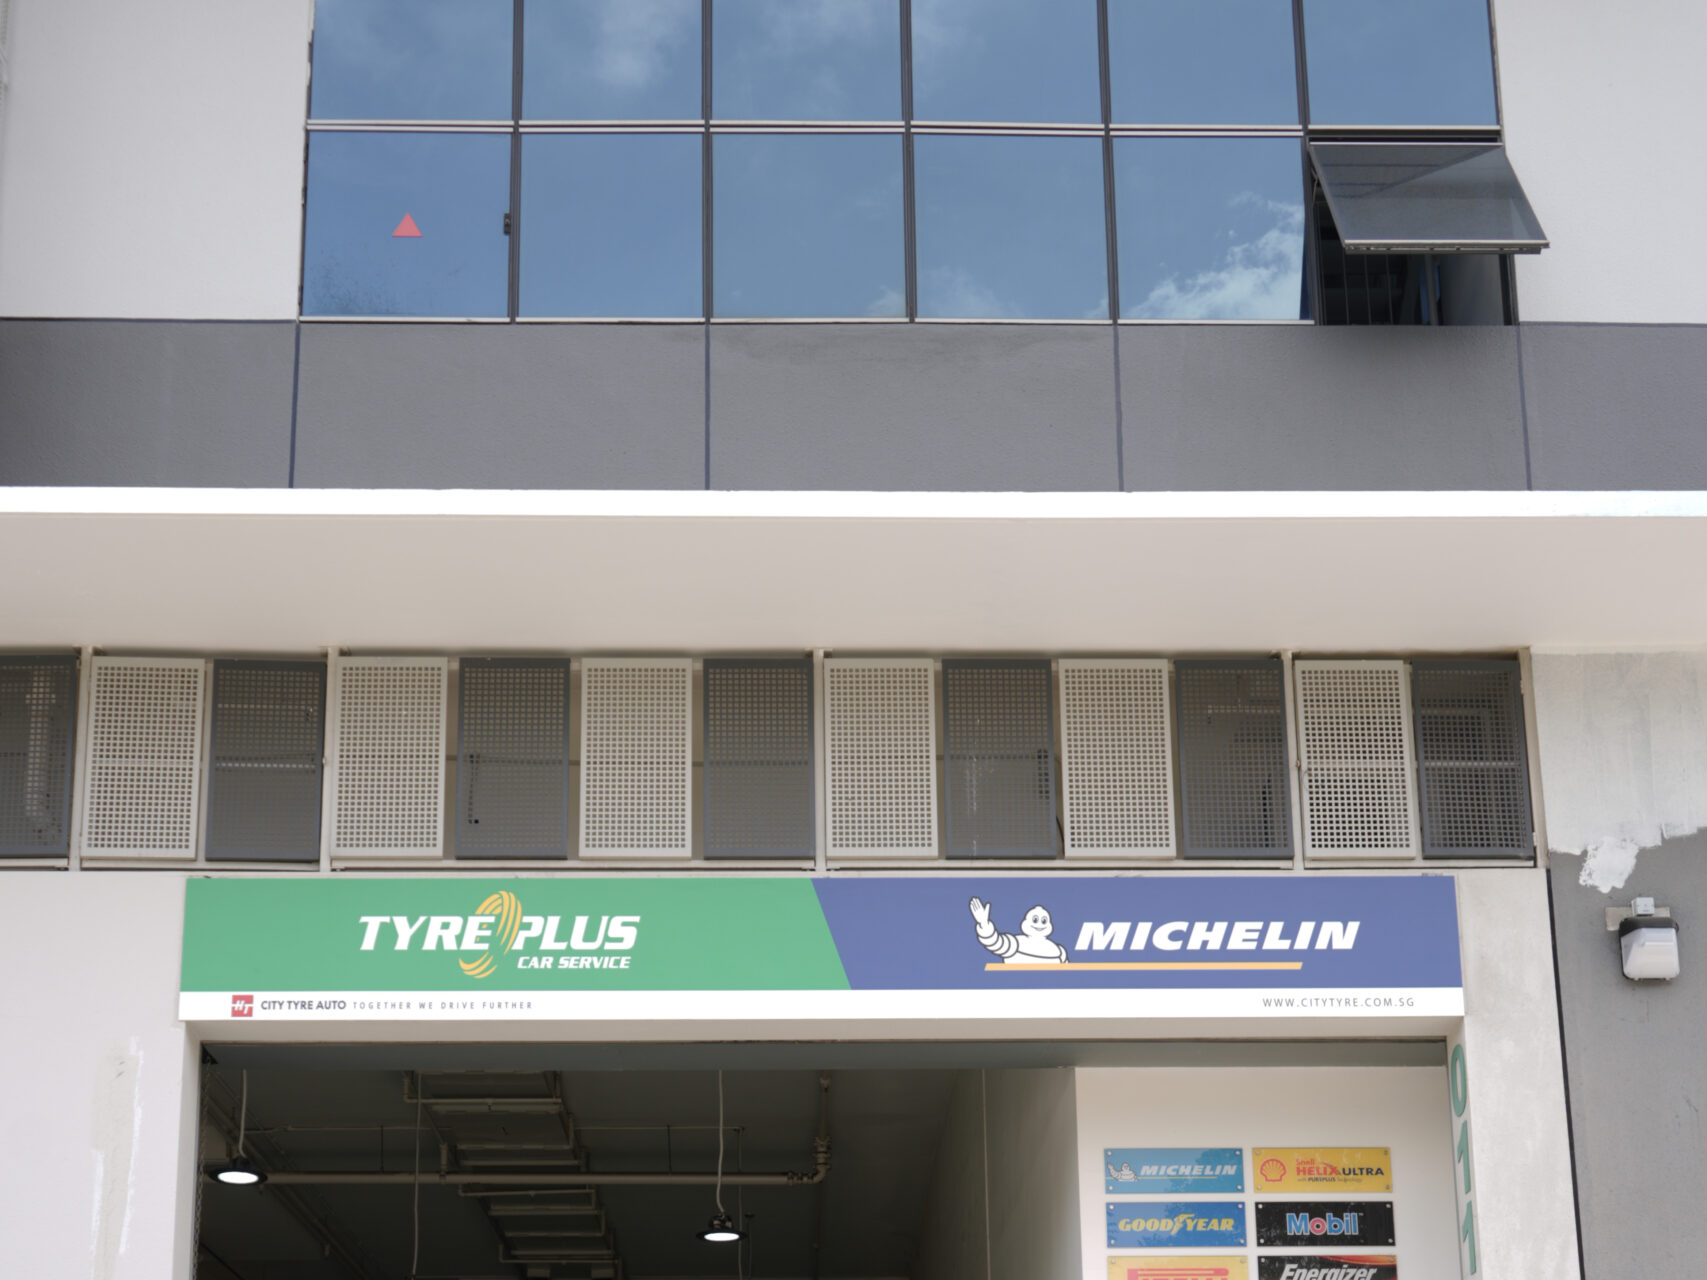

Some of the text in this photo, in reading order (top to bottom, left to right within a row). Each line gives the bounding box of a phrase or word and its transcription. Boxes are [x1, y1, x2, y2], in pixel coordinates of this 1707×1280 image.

[1074, 920, 1361, 951] MICHELIN
[517, 956, 631, 969] CAR SERVICE
[261, 1000, 532, 1010] CITY TYRE AUTO TOGETHER WE DRIVE FURTHER
[1262, 996, 1415, 1008] WWW.CITYTYRE.COM.SG
[1296, 1158, 1315, 1166] Shell
[1140, 1164, 1238, 1176] MICHELIN
[1296, 1166, 1384, 1176] HELIX ULTRA
[1286, 1212, 1359, 1236] Mobil
